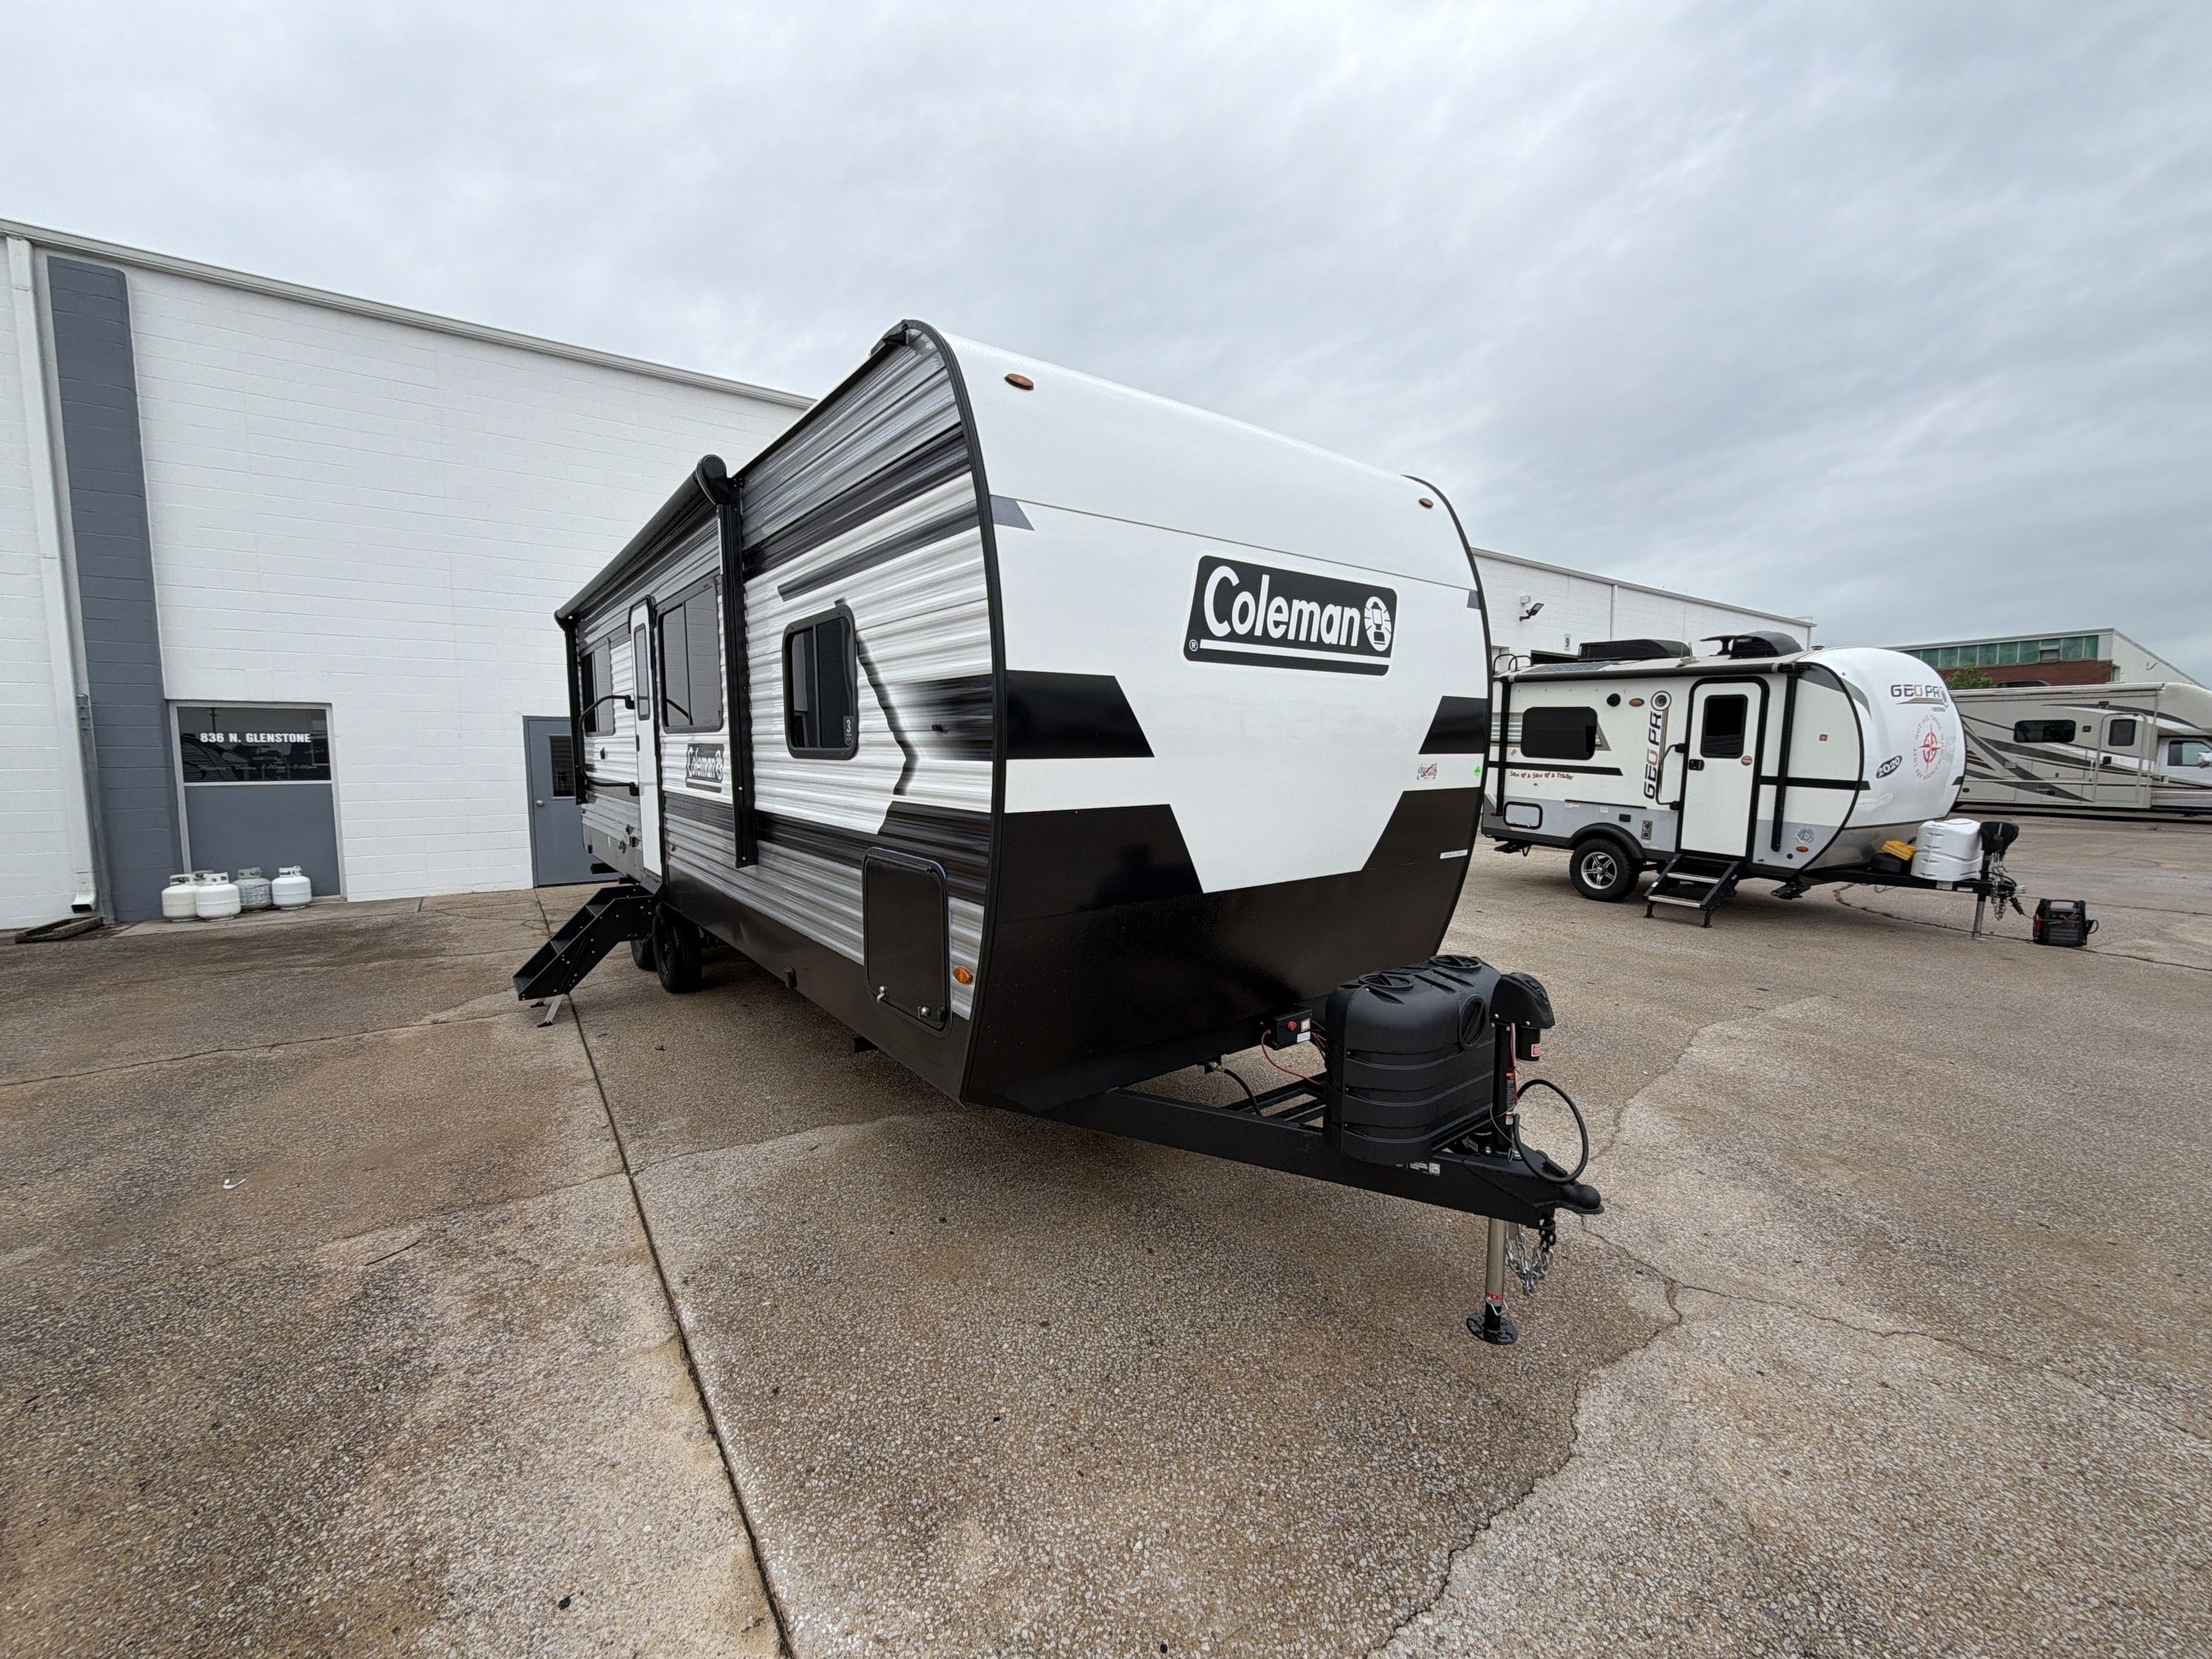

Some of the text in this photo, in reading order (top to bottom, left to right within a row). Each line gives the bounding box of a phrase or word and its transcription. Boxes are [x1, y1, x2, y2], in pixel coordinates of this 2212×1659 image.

[1204, 566, 1361, 647] Coleman
[1891, 684, 1923, 698] GEO
[846, 719, 852, 734] 3
[201, 732, 311, 743] 836 N. GLENSTONE
[687, 746, 715, 779] Coleman
[1878, 757, 1900, 777] 2020
[1644, 747, 1658, 800] GEO
